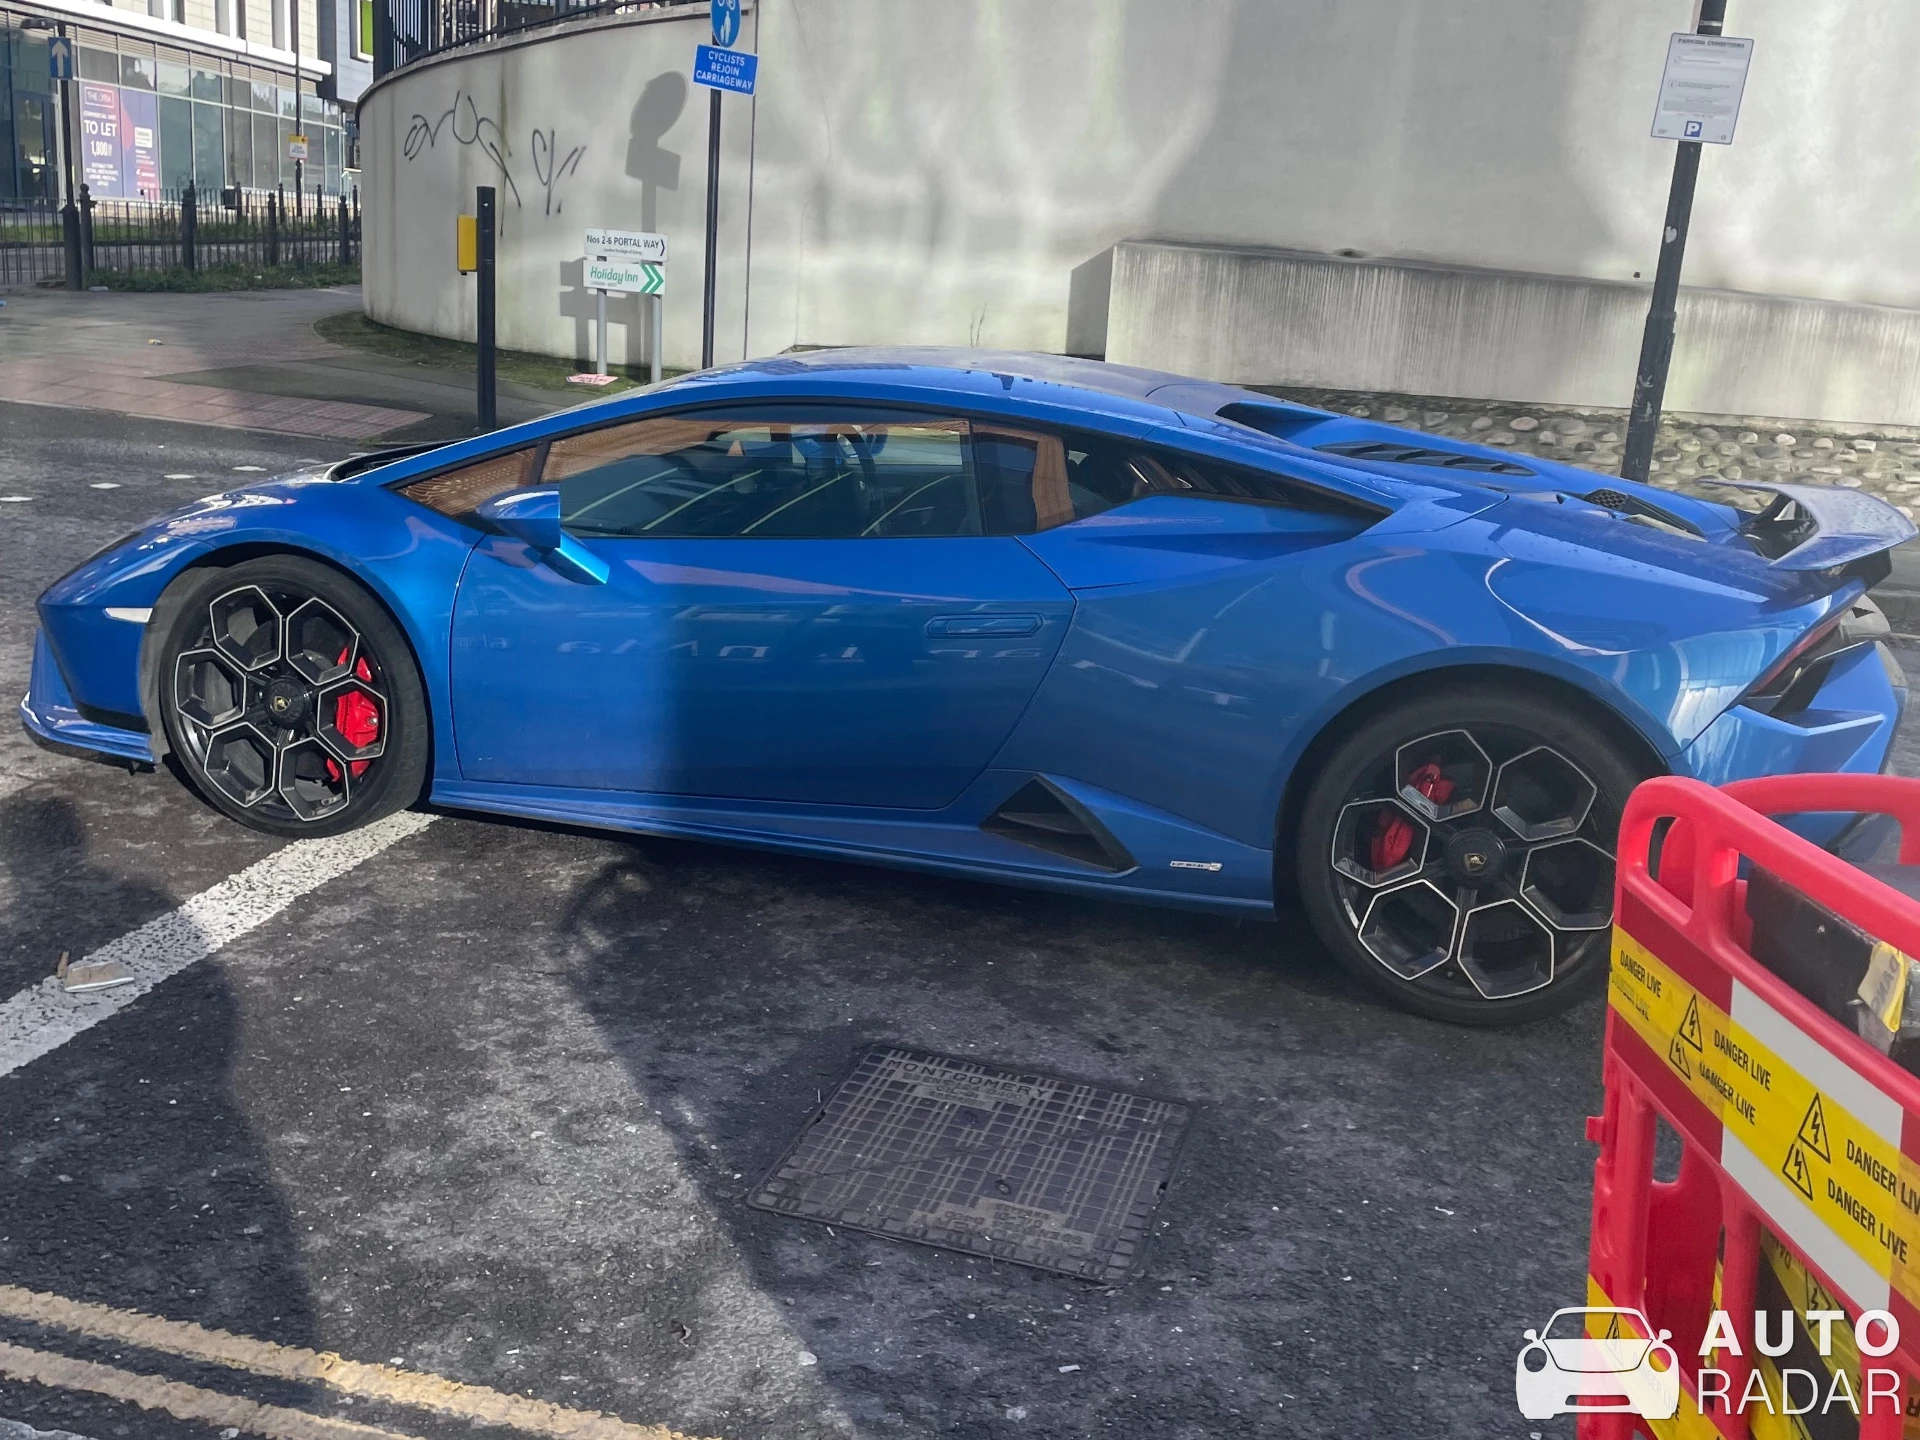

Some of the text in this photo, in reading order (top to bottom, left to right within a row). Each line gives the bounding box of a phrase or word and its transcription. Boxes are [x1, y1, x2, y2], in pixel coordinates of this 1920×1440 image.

[708, 50, 746, 66] CYCLISTS
[711, 62, 740, 76] REJOIN
[695, 69, 753, 90] CARRIAGEWAY
[83, 119, 117, 137] TO LET
[586, 235, 660, 249] Nos 2-6 PORTAL WAY
[590, 266, 639, 285] Holiday Inn
[1620, 950, 1646, 985] DANGER
[1647, 972, 1662, 999] LIVE
[1714, 1029, 1772, 1092] DANGER LIVE
[886, 1059, 1049, 1098] MONTGOMERY
[1699, 1061, 1756, 1126] DANGER LIVE
[1846, 1139, 1896, 1198] DANGER
[1827, 1177, 1908, 1265] DANGER LIVE
